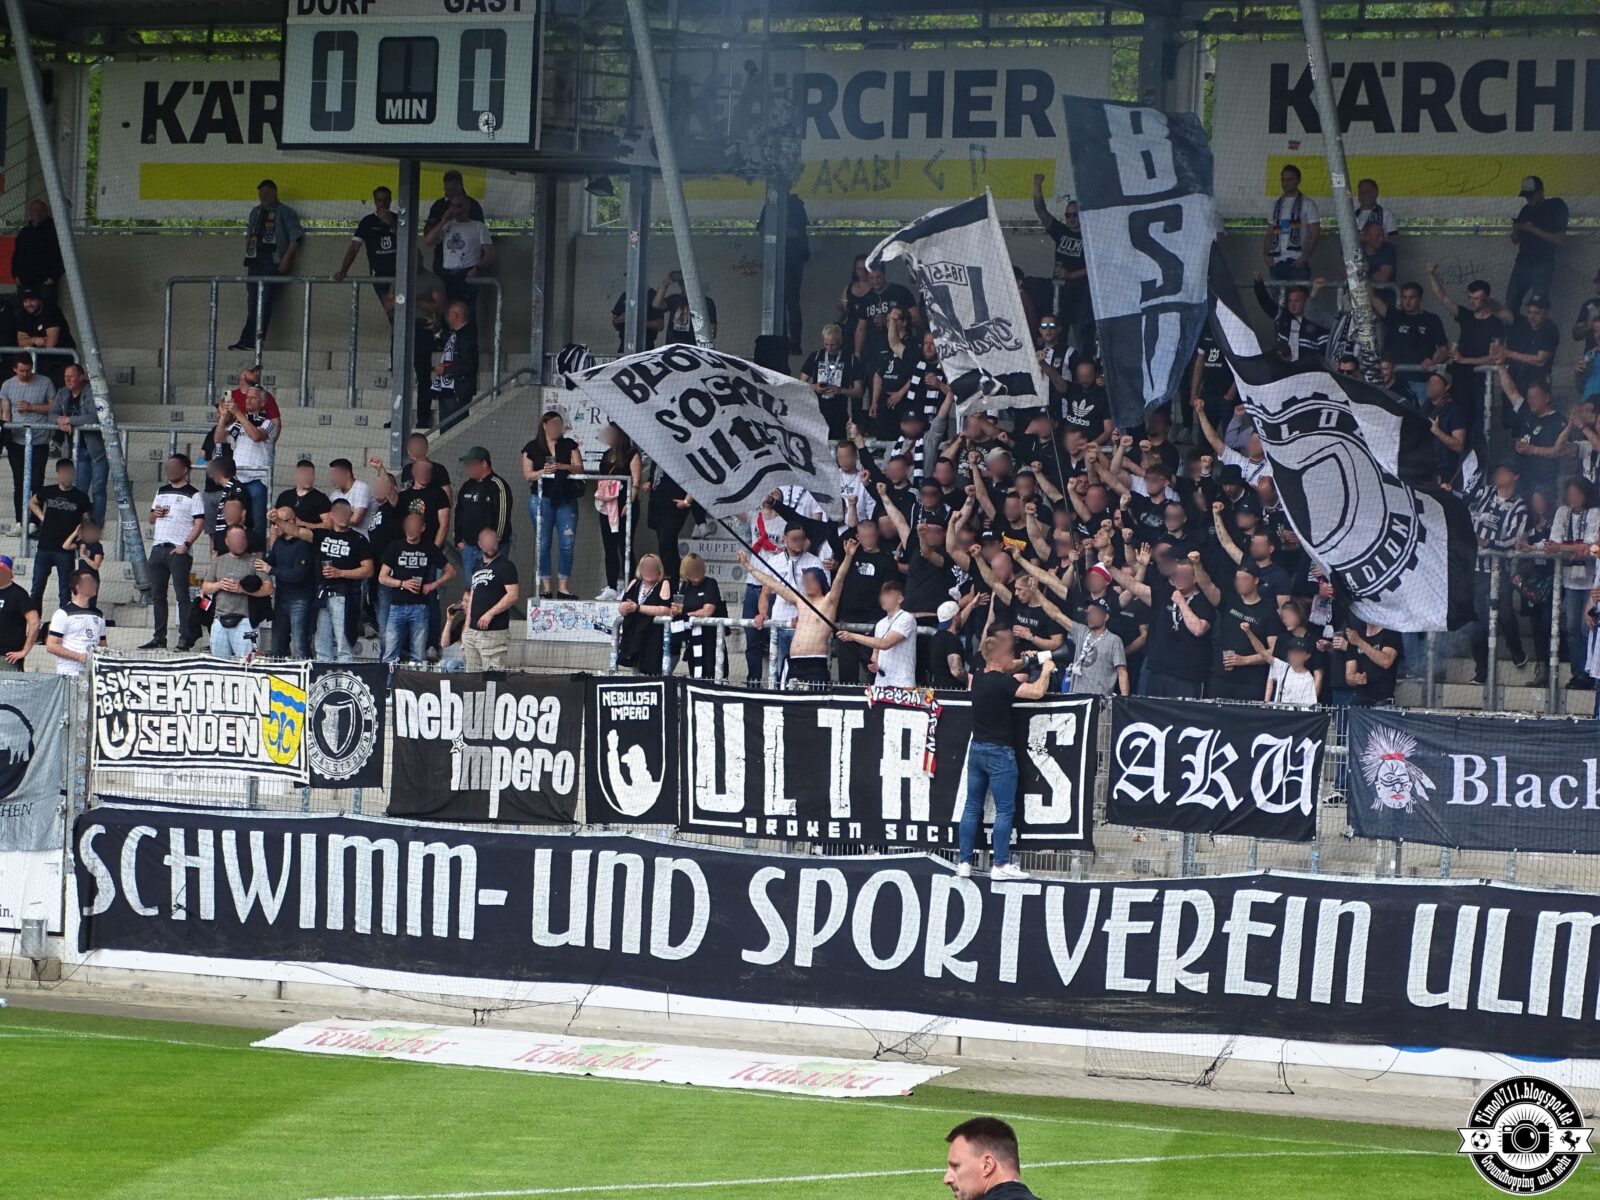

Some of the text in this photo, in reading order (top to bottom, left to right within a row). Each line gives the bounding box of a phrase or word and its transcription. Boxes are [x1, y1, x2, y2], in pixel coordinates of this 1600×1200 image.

[385, 98, 427, 120] MIN
[799, 69, 1057, 140] RCHER
[1066, 415, 1090, 427] adidas
[96, 668, 131, 696] SSV
[128, 673, 272, 714] SEKTION
[602, 691, 658, 706] NEBULOSA
[395, 679, 561, 744] nebulosa
[610, 705, 650, 721] IMPERO
[138, 714, 259, 756] SENDEN
[450, 737, 576, 819] impero
[744, 817, 862, 839] BROKEN
[78, 823, 508, 940] SCHWIMM-
[531, 848, 711, 961] UND
[740, 866, 1372, 1005] SPORTVEREIN
